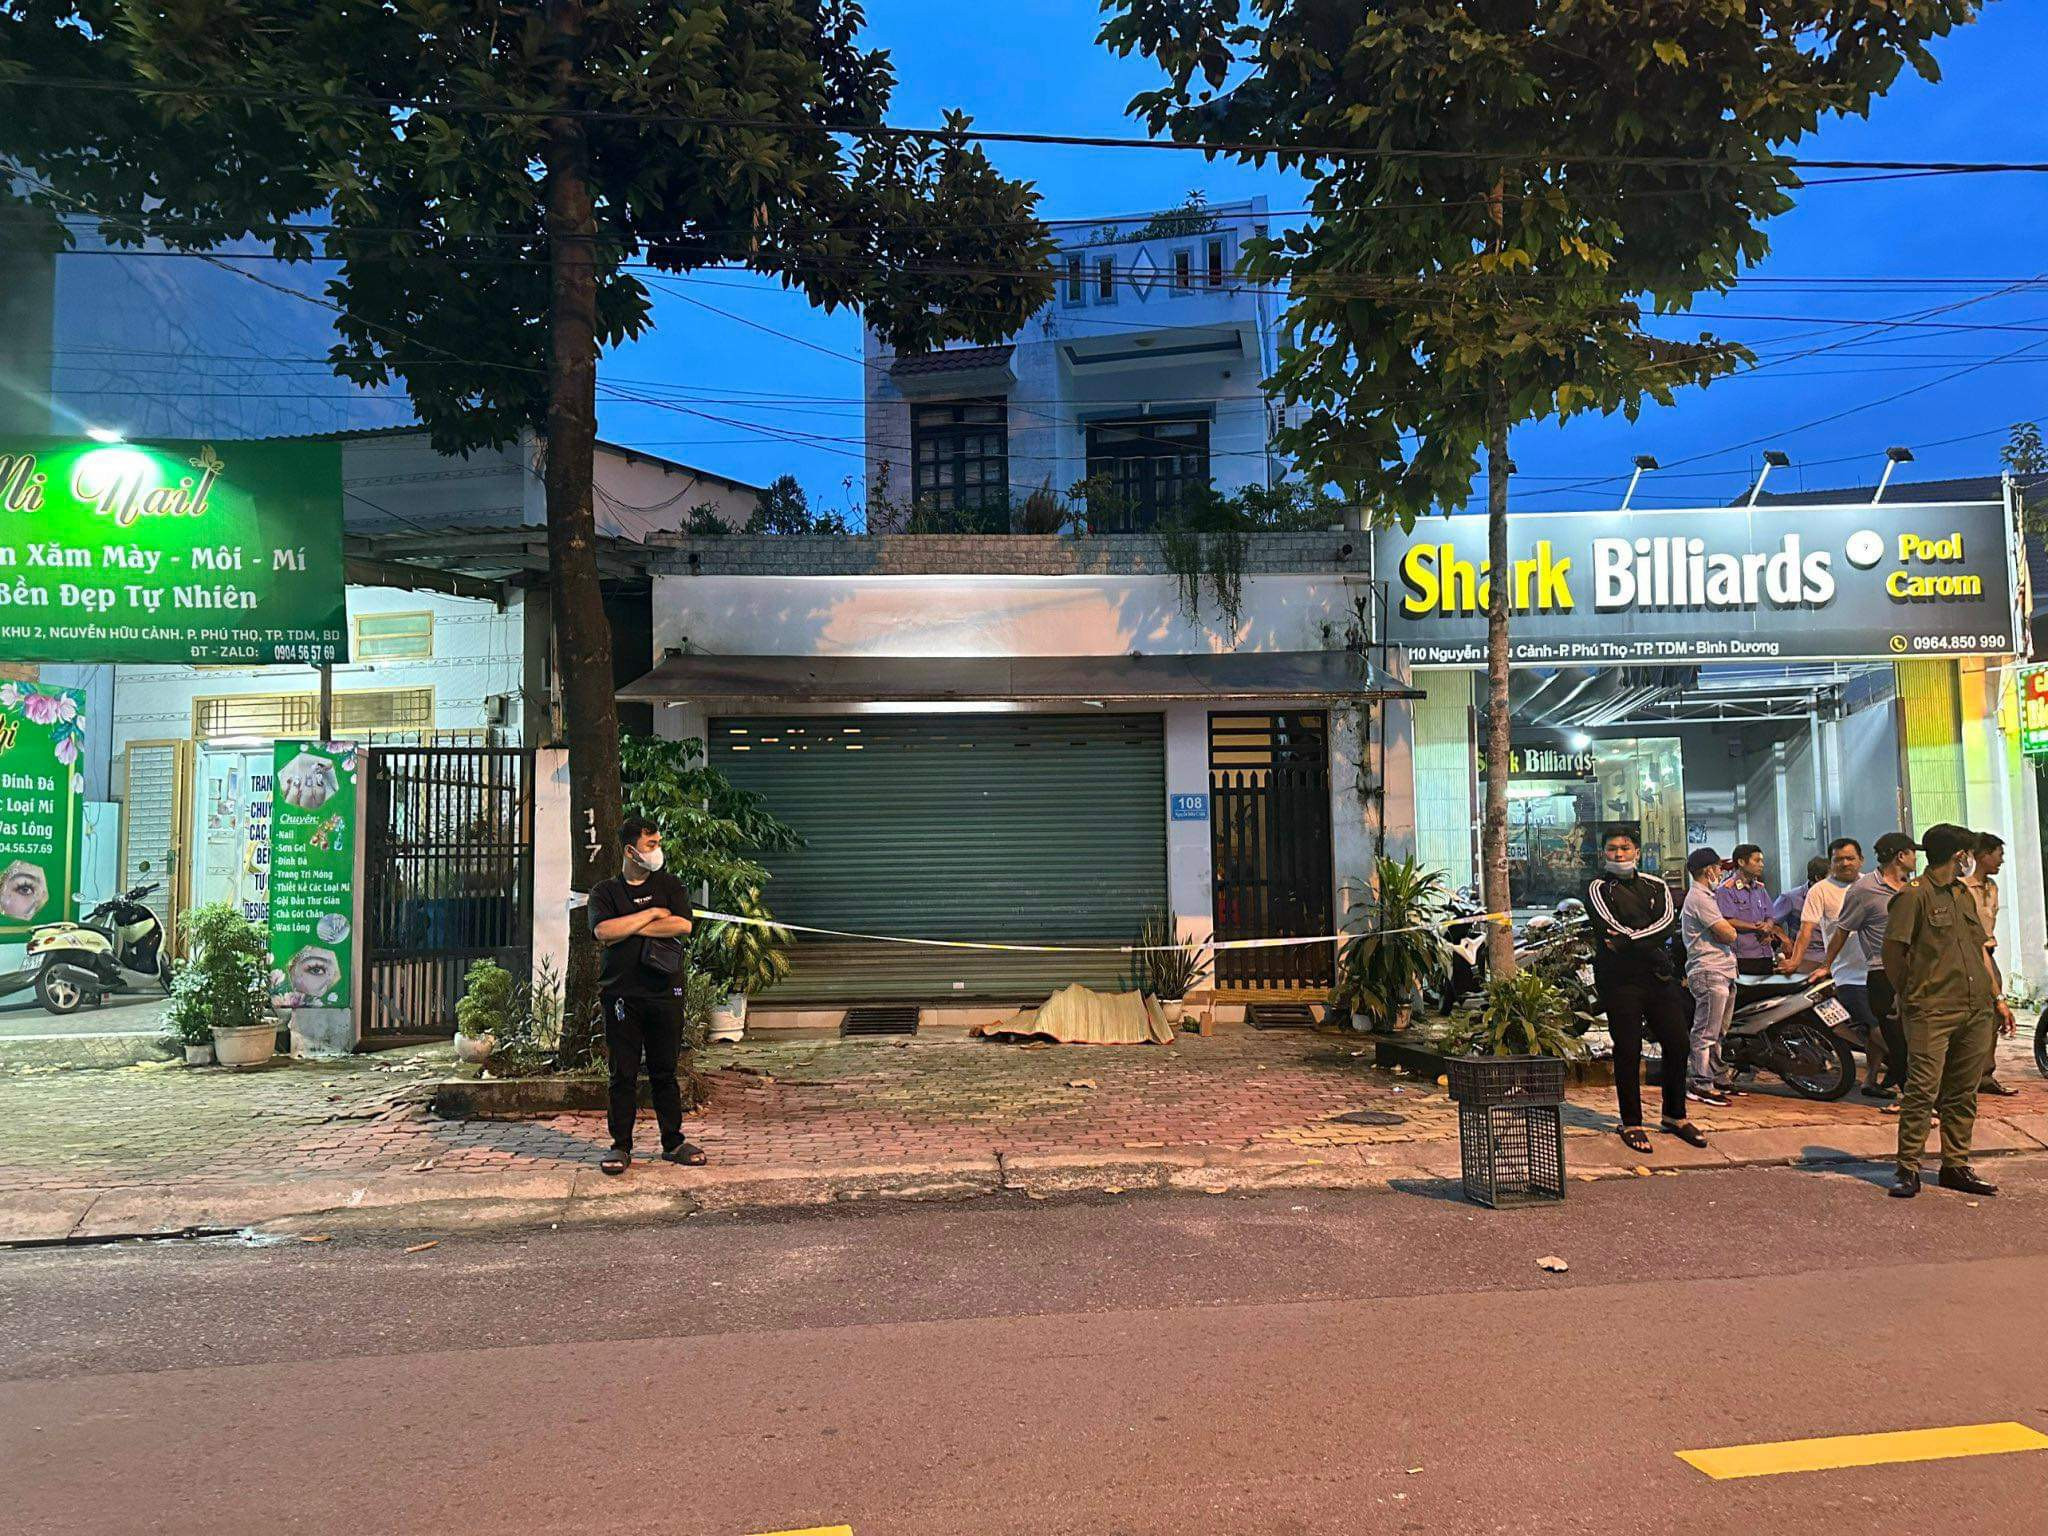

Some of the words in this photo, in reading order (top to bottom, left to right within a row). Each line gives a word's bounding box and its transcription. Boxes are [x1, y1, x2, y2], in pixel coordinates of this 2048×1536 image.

[74, 463, 217, 527] Nail
[1898, 532, 1962, 560] Pool
[26, 541, 92, 567] Xăm
[102, 544, 161, 573] Mày
[191, 546, 242, 570] Môi
[272, 547, 306, 571] Mí
[1593, 533, 1836, 606] Billiards
[1885, 570, 1982, 597] Carom
[59, 584, 116, 612] Đẹp
[124, 584, 164, 613] Tự
[174, 585, 258, 609] Nhiên
[2, 626, 31, 637] KHU
[34, 626, 46, 639] 2,
[50, 623, 106, 638] NGUYỄN
[109, 625, 138, 639] HỮU
[201, 627, 228, 640] PHÚ
[1571, 643, 1598, 657] Phú
[1730, 640, 1779, 656] Dương
[1980, 635, 2006, 648] 990
[220, 646, 259, 657] ZALO:
[274, 645, 296, 660] 0904
[298, 645, 309, 660] 56
[310, 645, 322, 660] 57
[324, 645, 335, 660] 69
[1429, 645, 1480, 662] Nguyễn
[1523, 748, 1593, 773] Billiards
[2, 773, 33, 789] Đính
[38, 776, 54, 791] Đá
[6, 798, 34, 816] Loại
[1178, 796, 1202, 809] 108
[22, 821, 53, 839] Lông
